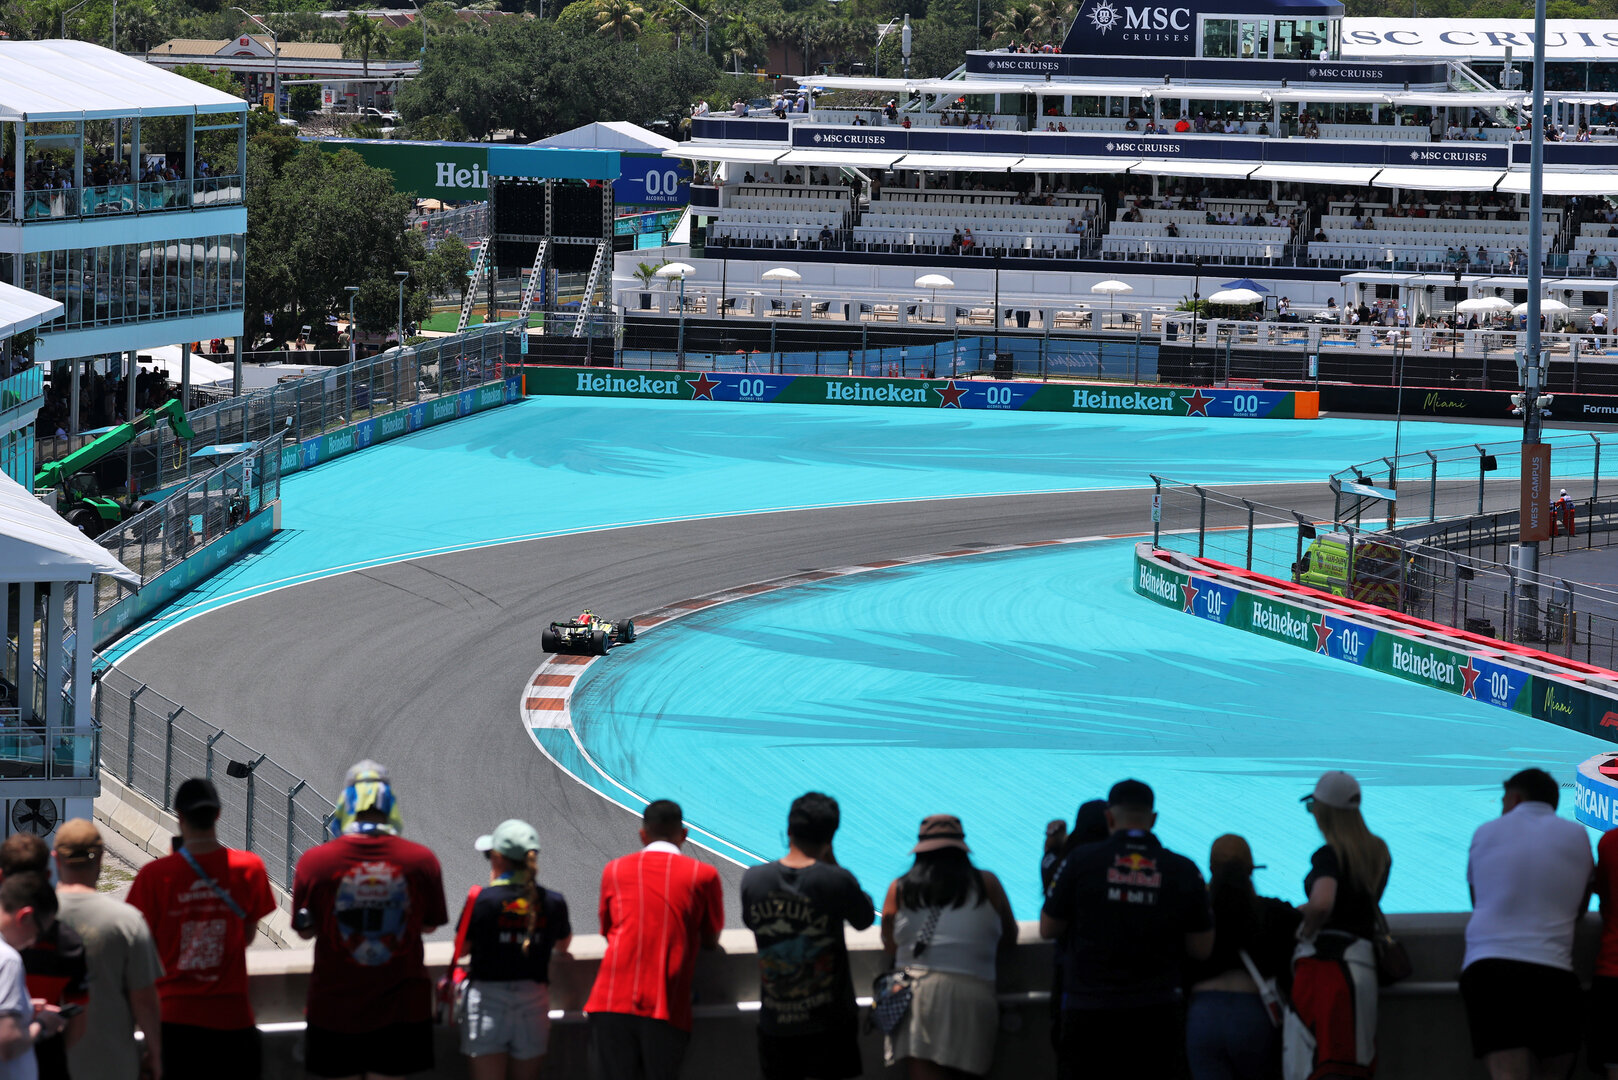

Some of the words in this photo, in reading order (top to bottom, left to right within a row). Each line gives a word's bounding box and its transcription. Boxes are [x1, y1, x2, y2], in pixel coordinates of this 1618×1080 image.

[1124, 6, 1190, 31] MSC
[1123, 33, 1189, 42] CRUISES
[997, 61, 1016, 69] MSC
[1018, 61, 1059, 70] CRUISES
[1319, 68, 1339, 77] MSC
[1341, 69, 1383, 79] CRUISES
[823, 134, 842, 143] MSC
[844, 135, 885, 144] CRUISES
[1116, 143, 1136, 151] MSC
[1137, 143, 1180, 153] CRUISES
[1420, 151, 1441, 160] MSC
[1443, 152, 1487, 161] CRUISES
[646, 170, 678, 196] 0.0
[576, 373, 679, 395] Heineken
[740, 379, 764, 396] 0.0
[826, 381, 927, 402] Heineken
[987, 387, 1011, 404] 0.0
[1072, 390, 1174, 411] Heineken
[1233, 395, 1258, 413] 0.0
[1423, 392, 1467, 413] Miami
[1531, 456, 1540, 499] CAMPUS
[1531, 502, 1539, 528] WEST
[1139, 564, 1178, 602] Heineken
[1252, 602, 1309, 641] Heineken
[1392, 643, 1455, 685] Heineken
[1543, 686, 1574, 717] Miami
